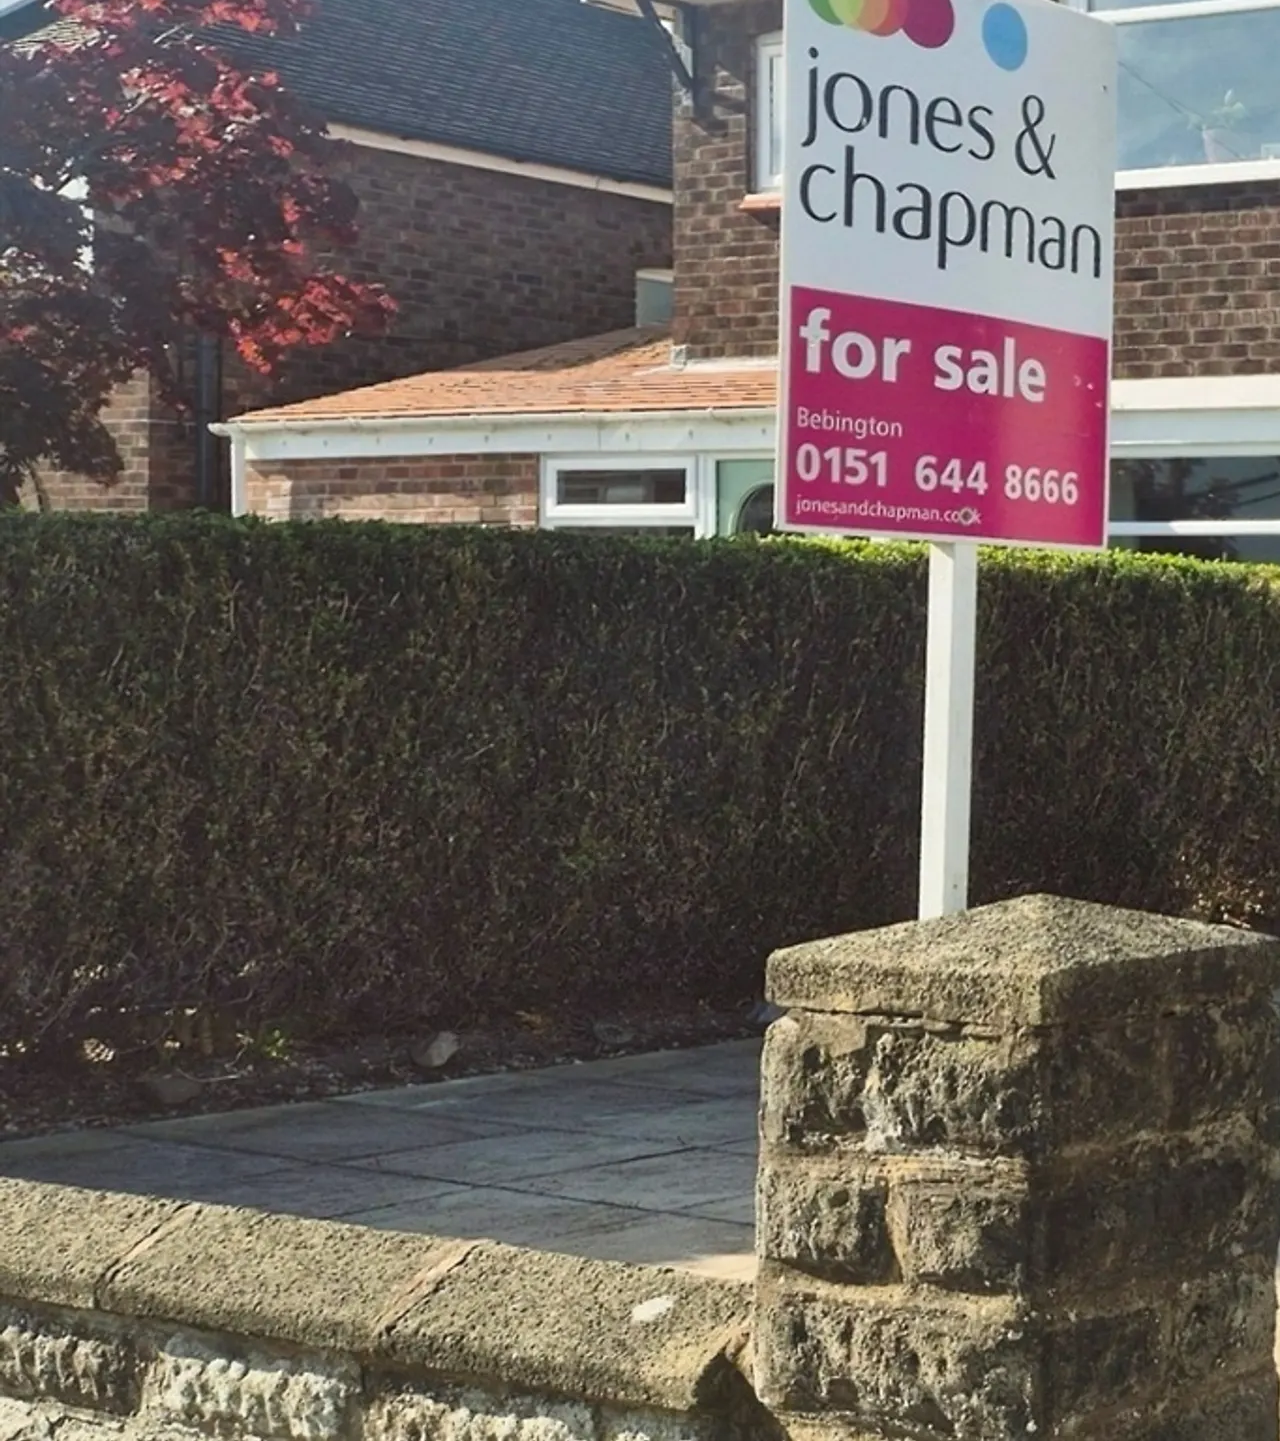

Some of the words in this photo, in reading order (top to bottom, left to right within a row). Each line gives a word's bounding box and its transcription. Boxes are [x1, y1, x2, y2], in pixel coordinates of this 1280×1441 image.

[801, 47, 995, 161] jones
[1014, 94, 1057, 179] &
[799, 145, 1102, 279] chapman
[799, 307, 911, 384] for
[933, 337, 1046, 402] sale
[797, 406, 903, 439] Bebington
[796, 443, 888, 487] 0151
[915, 455, 988, 495] 644
[1004, 464, 1079, 505] 8666
